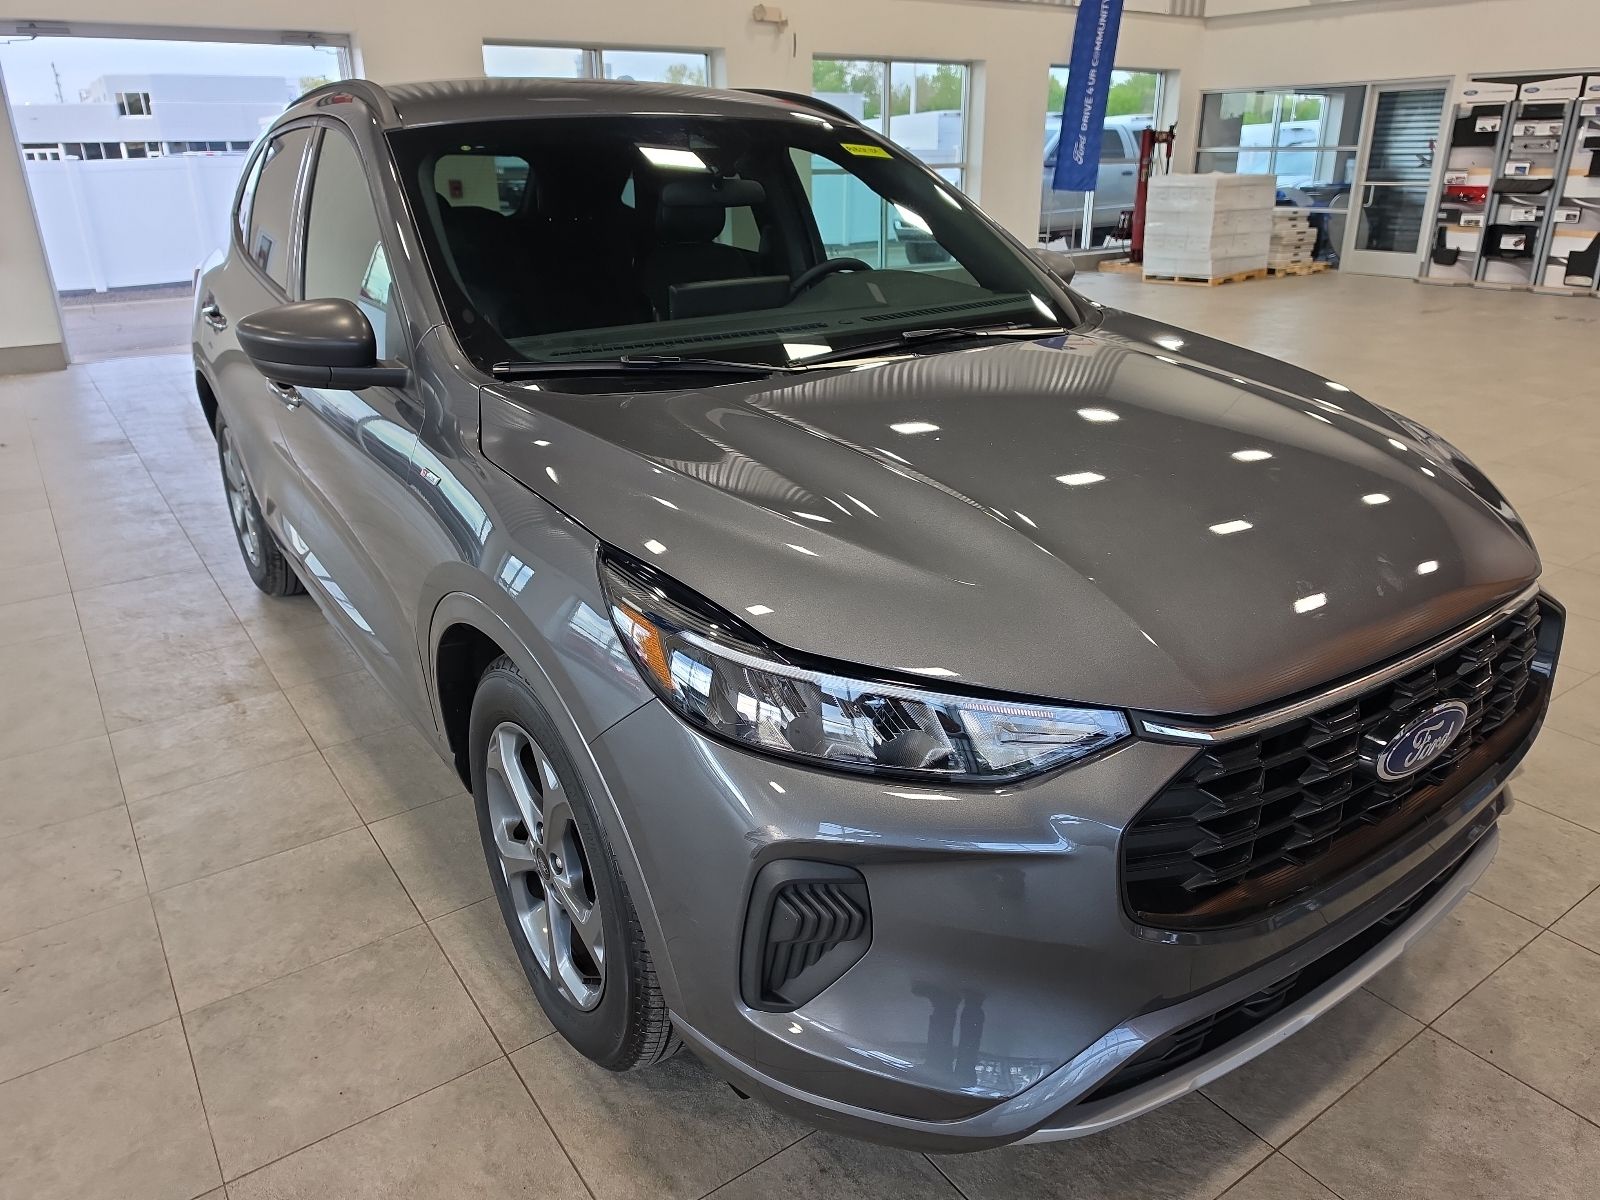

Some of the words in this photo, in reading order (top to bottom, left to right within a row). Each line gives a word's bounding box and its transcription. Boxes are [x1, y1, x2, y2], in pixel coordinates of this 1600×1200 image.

[1087, 68, 1098, 86] UR
[1081, 96, 1094, 131] DRIVE
[1072, 133, 1087, 165] Ford
[1404, 719, 1455, 768] Ford
